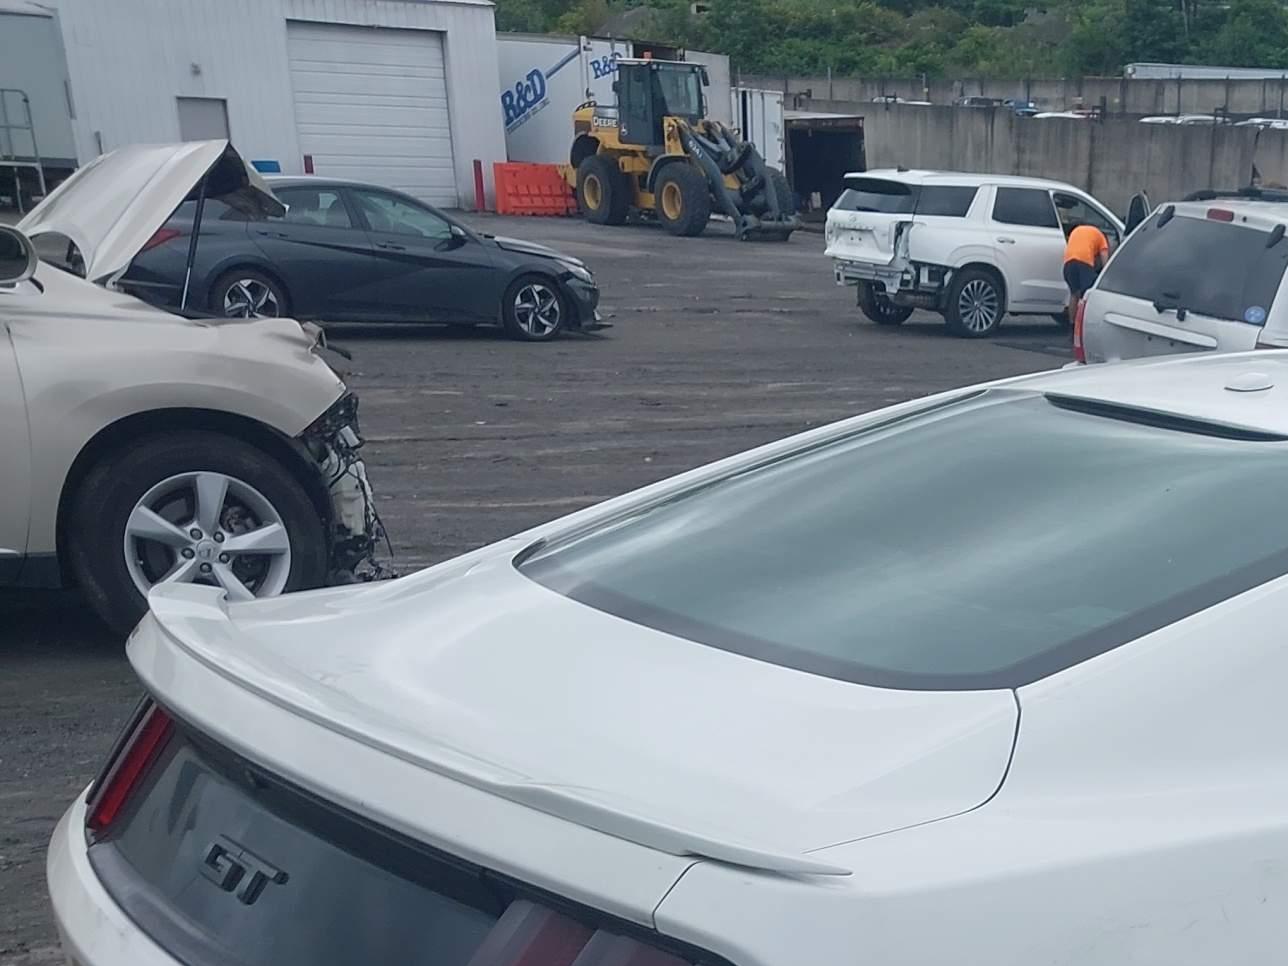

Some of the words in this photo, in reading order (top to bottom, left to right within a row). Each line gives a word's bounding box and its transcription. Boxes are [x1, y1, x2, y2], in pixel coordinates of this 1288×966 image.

[501, 68, 546, 127] R&D
[593, 116, 618, 128] DEERE
[199, 833, 290, 905] GT
